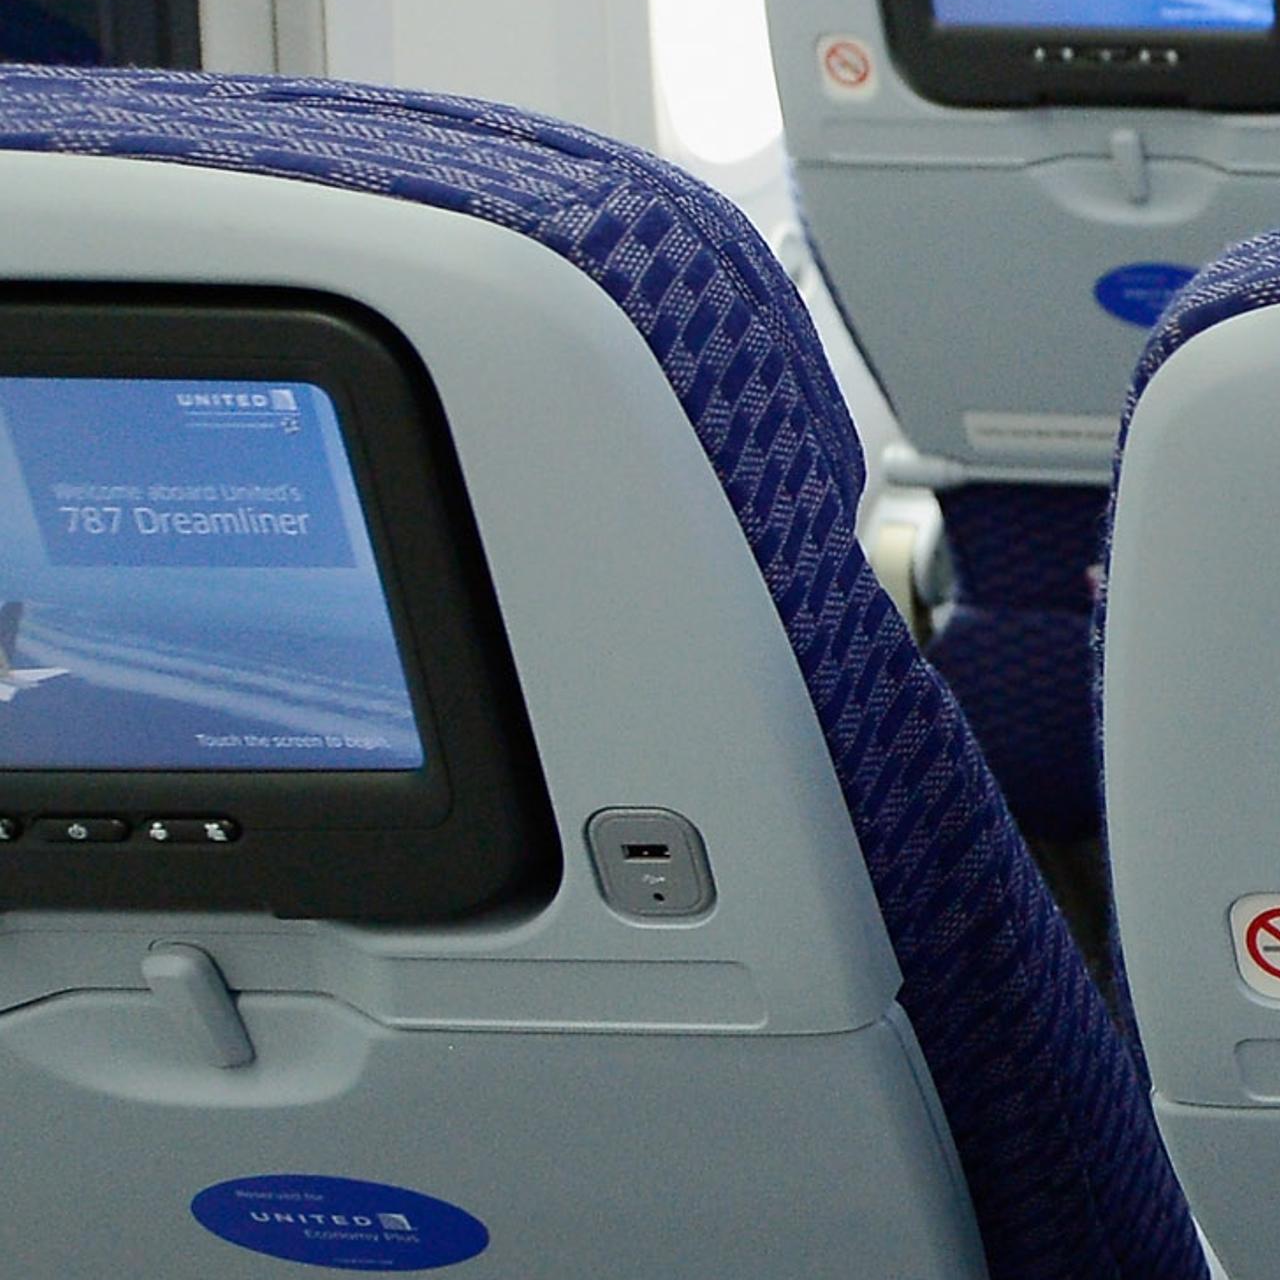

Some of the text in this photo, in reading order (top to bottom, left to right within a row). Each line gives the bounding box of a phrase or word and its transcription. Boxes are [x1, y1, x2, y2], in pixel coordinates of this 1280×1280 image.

[176, 393, 268, 407] UNITED
[59, 506, 309, 536] 787 Dreamliner
[249, 1211, 373, 1227] UNITED
[303, 1228, 420, 1244] Economy Plus
